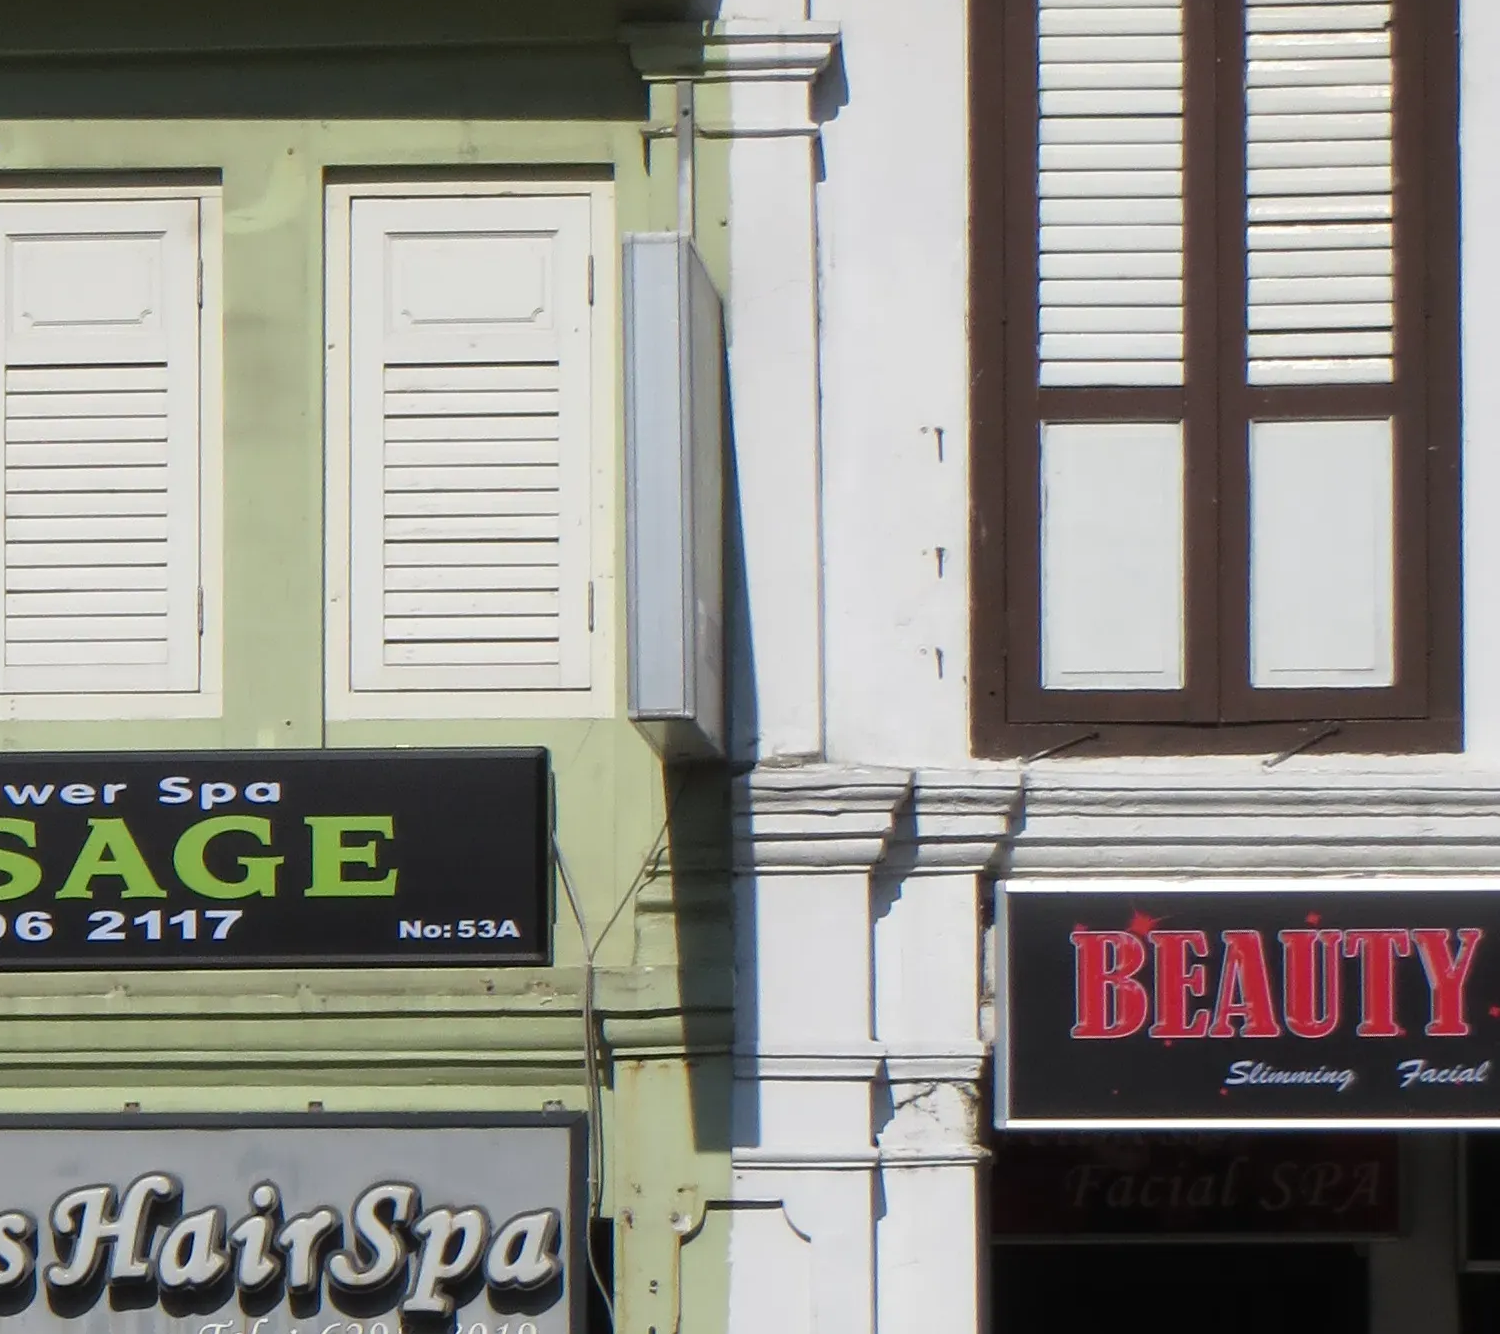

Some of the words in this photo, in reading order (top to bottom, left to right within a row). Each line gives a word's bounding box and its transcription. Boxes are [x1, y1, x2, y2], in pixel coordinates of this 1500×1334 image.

[157, 775, 282, 810] Spa
[87, 909, 244, 942] 2117
[1070, 928, 1483, 1038] BEAUTY
[1225, 1060, 1355, 1091] Slimming
[1397, 1058, 1490, 1088] Facial
[1065, 1157, 1248, 1208] Facial
[1259, 1160, 1382, 1212] SPA
